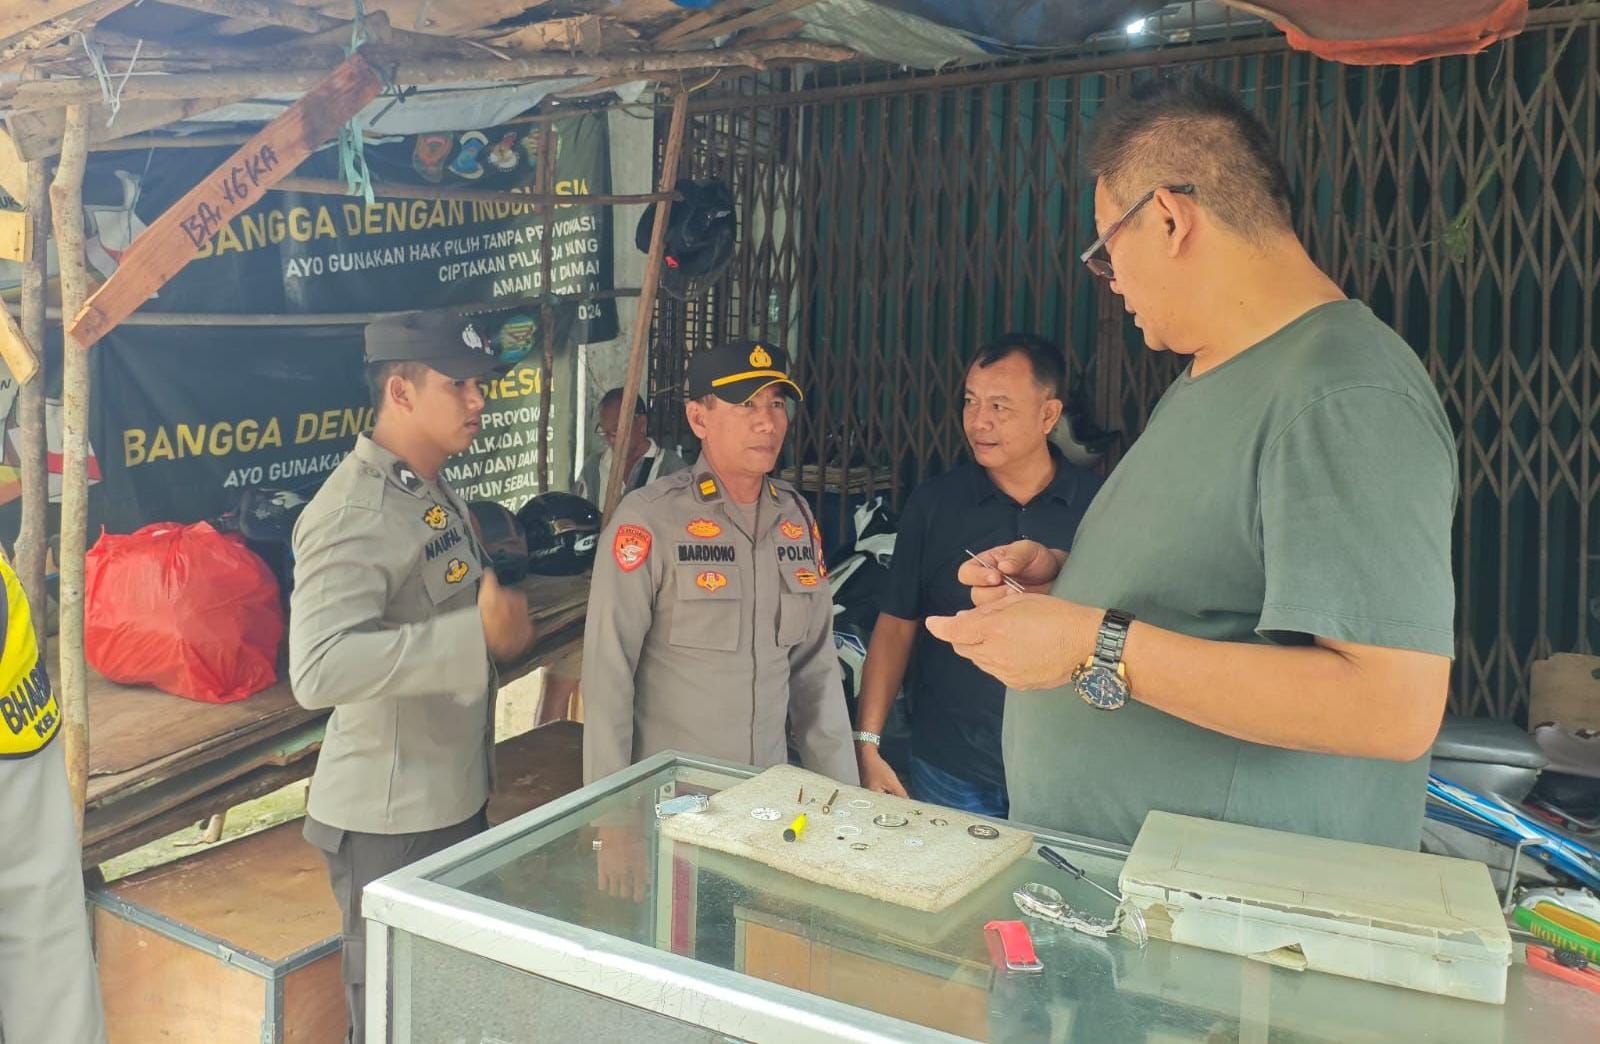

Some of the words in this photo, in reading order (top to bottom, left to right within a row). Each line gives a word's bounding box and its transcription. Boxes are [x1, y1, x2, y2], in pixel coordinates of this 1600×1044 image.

[342, 197, 464, 236] DENGAN
[286, 256, 323, 278] AYO
[329, 246, 404, 272] GUNAKAN
[409, 241, 441, 261] HAK
[444, 236, 480, 256] PILIH
[483, 229, 524, 249] TANPA
[439, 255, 505, 282] CIPTAKAN
[508, 244, 562, 270] PILKDA
[493, 274, 531, 297] AMAN
[533, 268, 557, 288] DN
[122, 416, 283, 468] BANGGA
[224, 466, 263, 488] AYO
[269, 451, 349, 480] GUNAKA
[484, 454, 517, 475] DAN
[425, 527, 462, 561] NAUFAL
